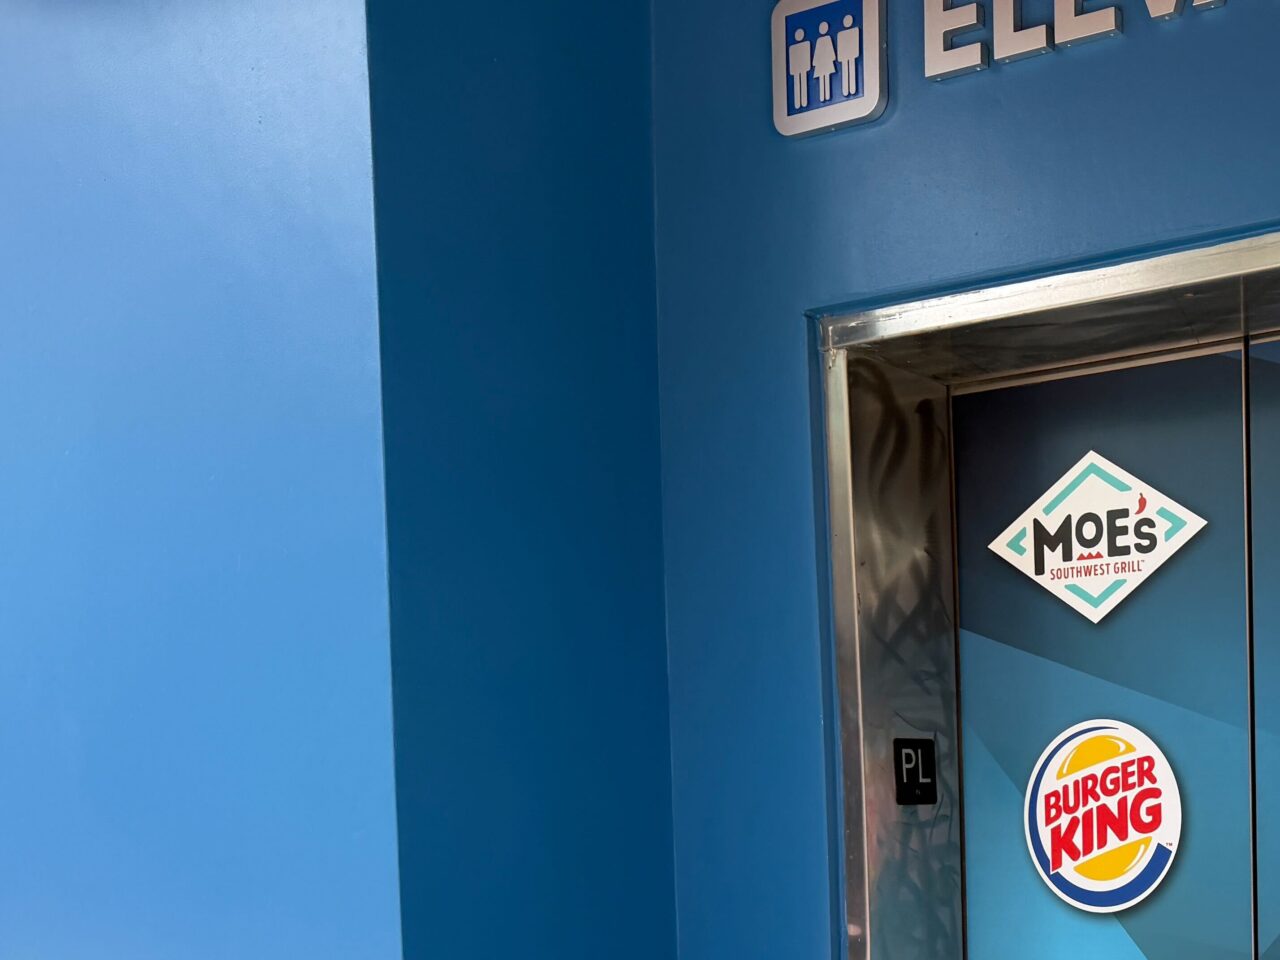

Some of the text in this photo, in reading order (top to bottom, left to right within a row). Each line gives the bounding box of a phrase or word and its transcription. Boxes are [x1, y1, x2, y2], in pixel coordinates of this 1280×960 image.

[1050, 562, 1110, 581] SOUTHWEST
[902, 748, 931, 783] PL
[1044, 755, 1157, 827] BURGER
[1051, 787, 1162, 872] KING
